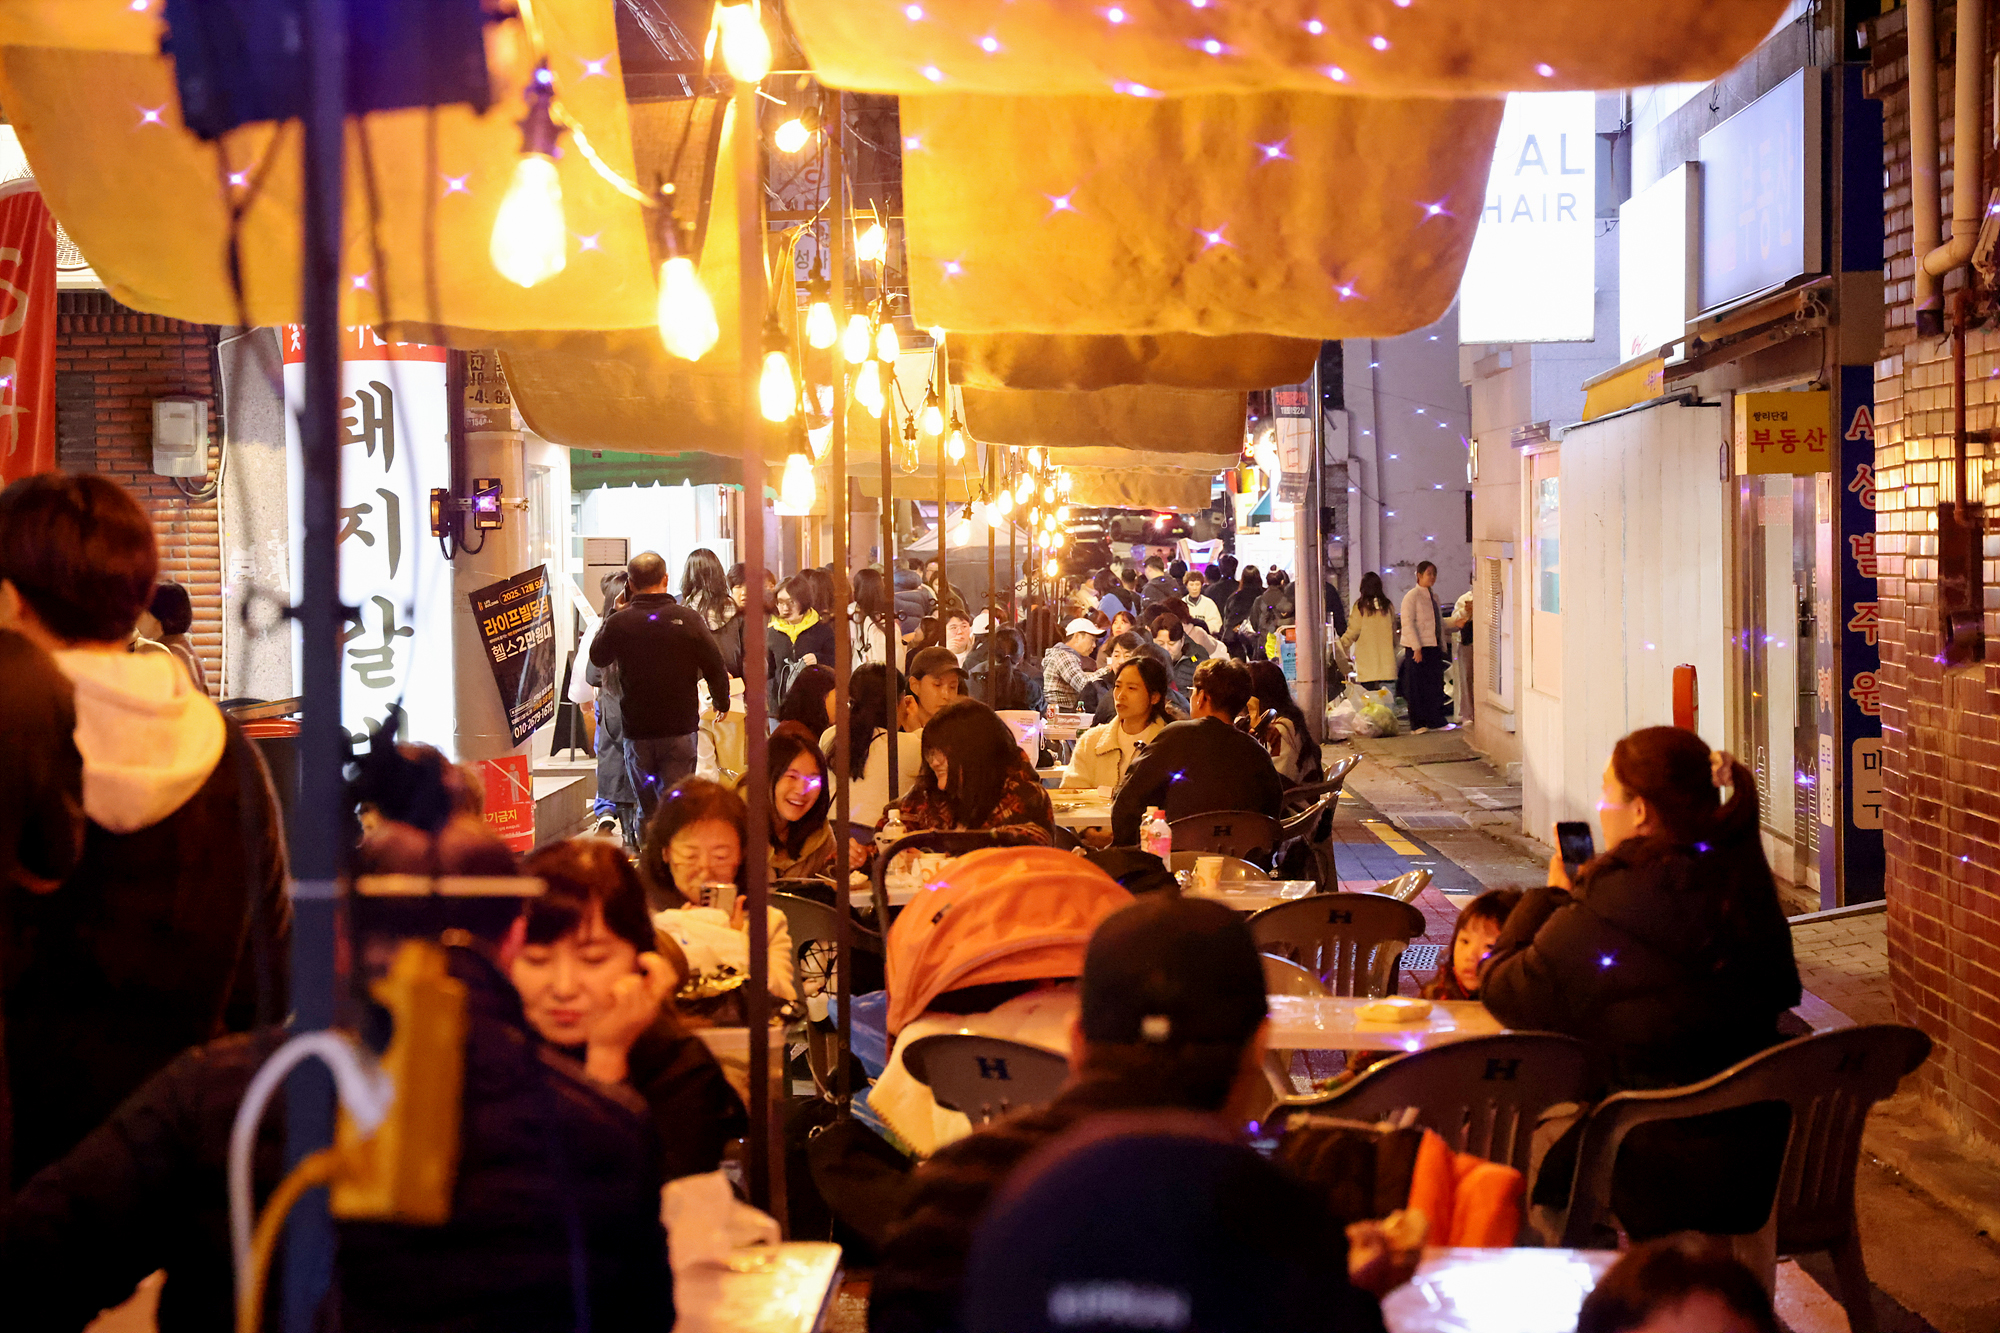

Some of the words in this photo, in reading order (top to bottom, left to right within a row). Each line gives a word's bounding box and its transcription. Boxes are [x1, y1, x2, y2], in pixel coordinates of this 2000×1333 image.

[1482, 192, 1577, 223] HAIR
[1750, 427, 1827, 454] 부동산
[502, 591, 521, 602] 2025.
[483, 595, 549, 636] 라이프빌딩점
[491, 620, 553, 663] 헬스2만원대
[975, 1056, 1012, 1081] H
